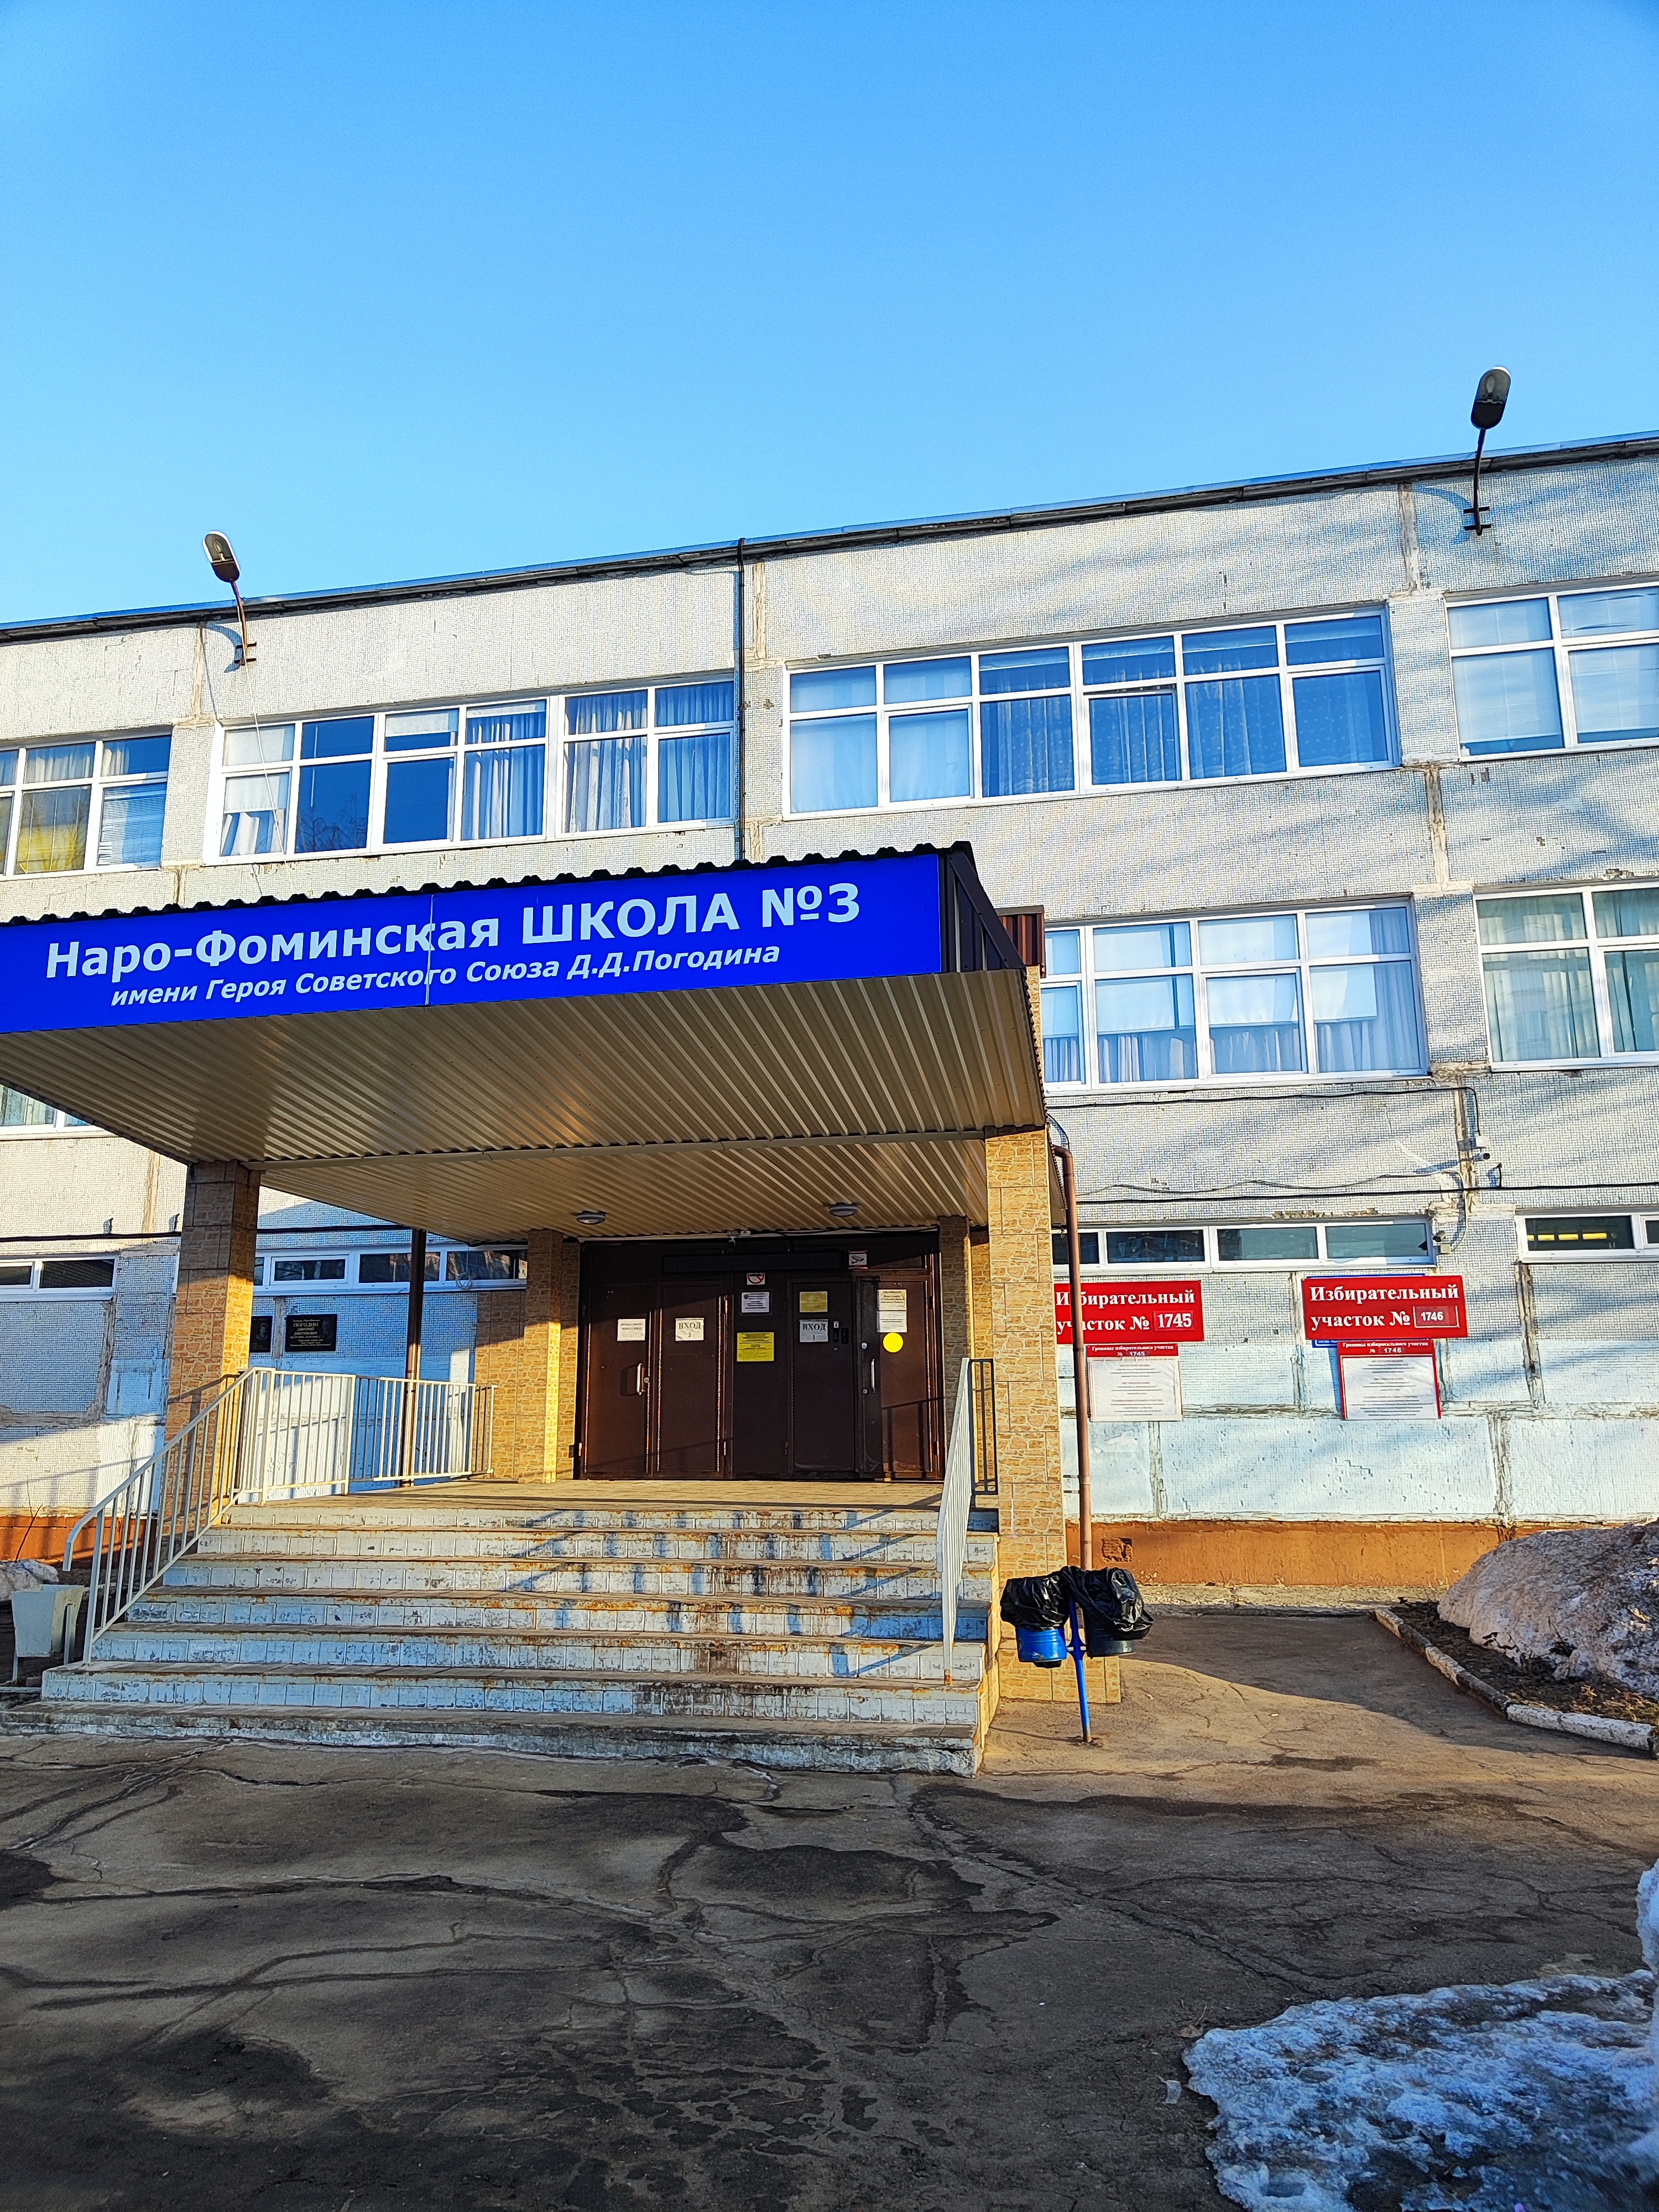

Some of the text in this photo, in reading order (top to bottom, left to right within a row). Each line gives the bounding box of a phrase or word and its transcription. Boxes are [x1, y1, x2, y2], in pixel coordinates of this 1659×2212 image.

[46, 883, 859, 983] Наро-Фоминская ШКОЛА №3
[111, 946, 780, 1006] имени Героя Советского Союза Д.Д.Погодина
[1055, 1289, 1196, 1309] Ибирательный
[1309, 1284, 1459, 1305] Избирательный
[679, 1322, 702, 1330] ВХОД
[802, 1323, 826, 1332] ВХОД
[1129, 1316, 1150, 1331] №
[1156, 1313, 1192, 1328] 1745
[1310, 1311, 1444, 1331] участок № 1746
